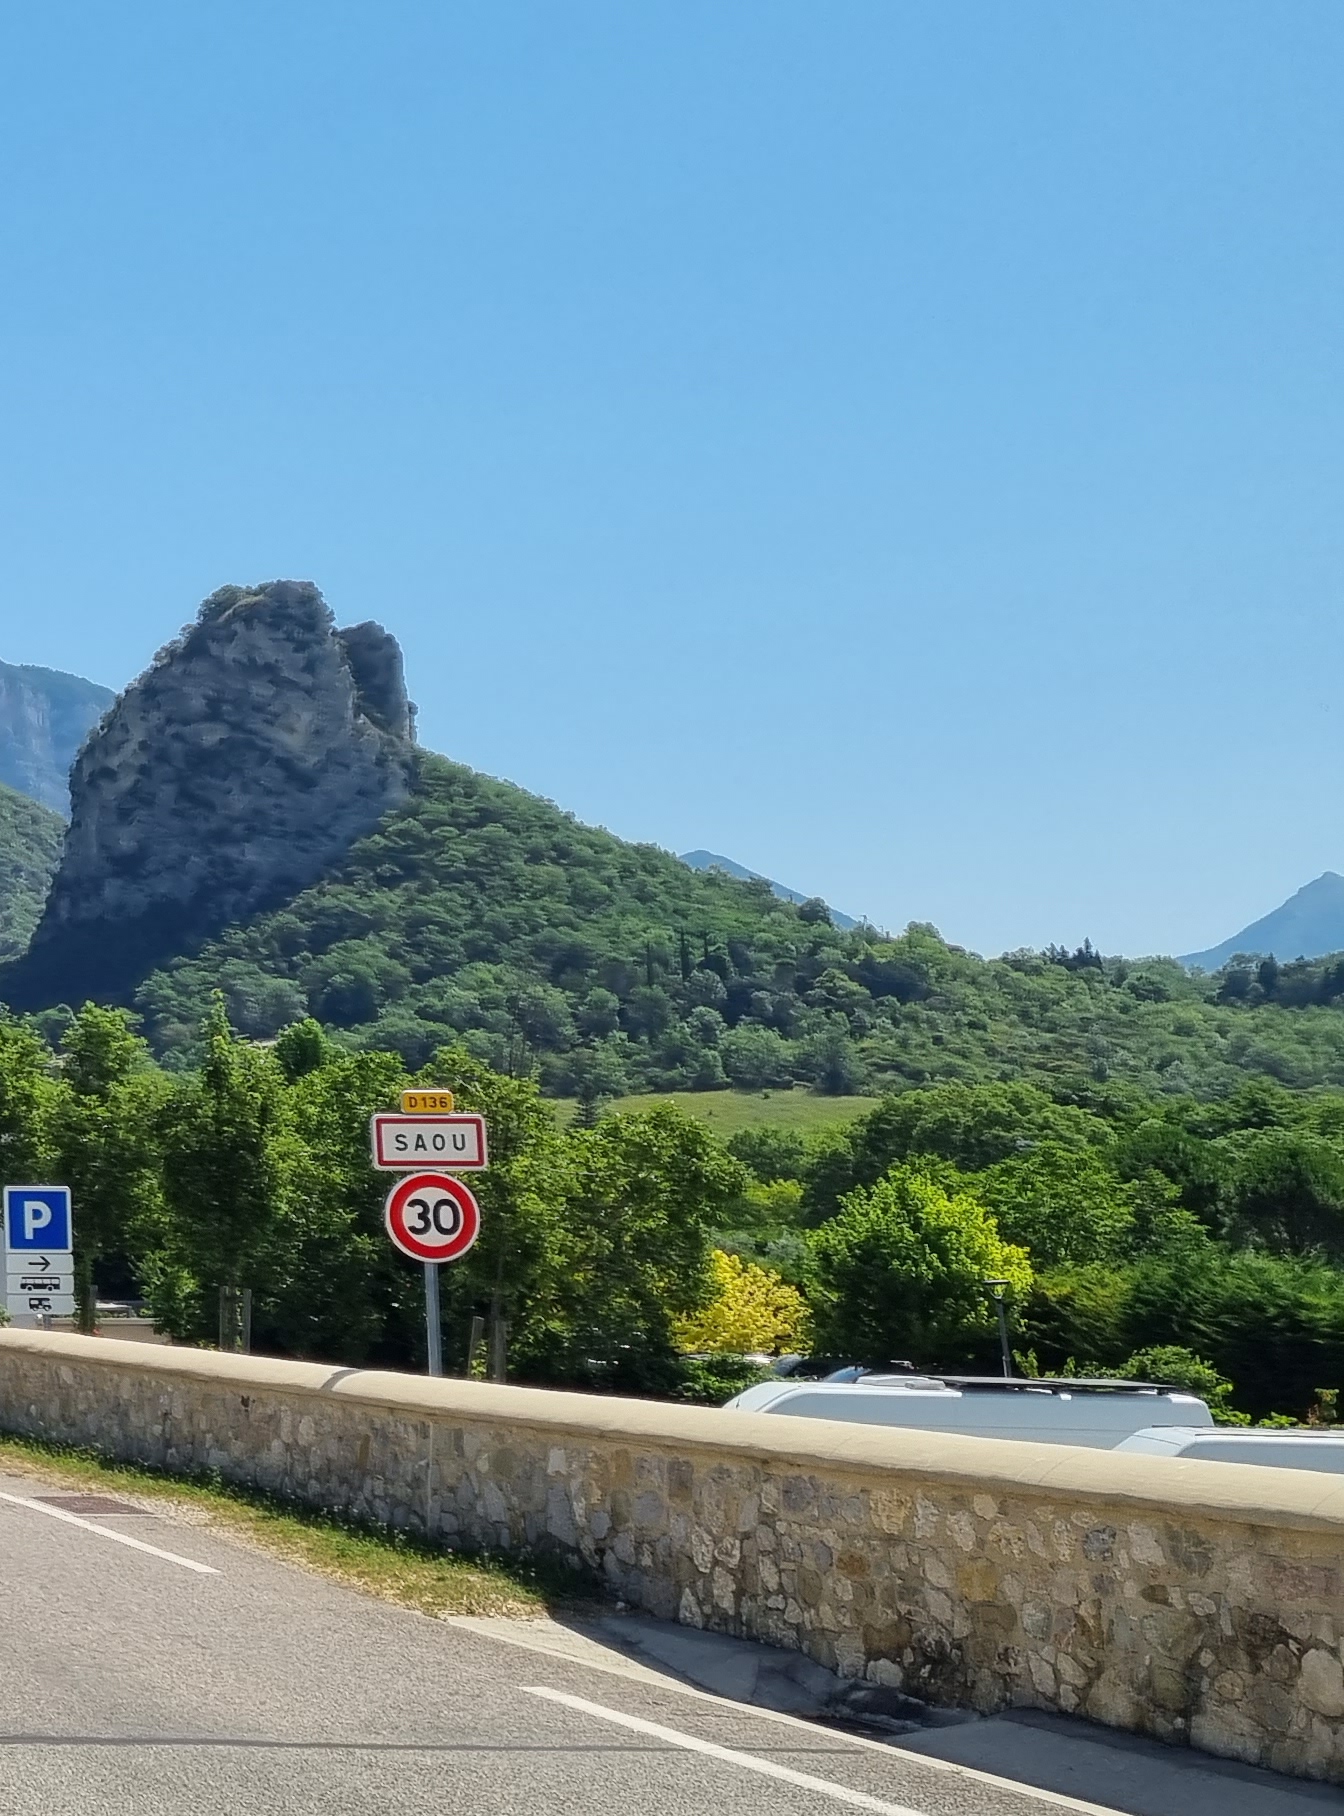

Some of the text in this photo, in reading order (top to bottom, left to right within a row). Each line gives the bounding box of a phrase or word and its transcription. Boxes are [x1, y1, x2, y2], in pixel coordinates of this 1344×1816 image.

[409, 1096, 448, 1108] D 136
[394, 1133, 467, 1152] SAOU
[24, 1200, 52, 1240] P
[406, 1198, 461, 1235] 30
